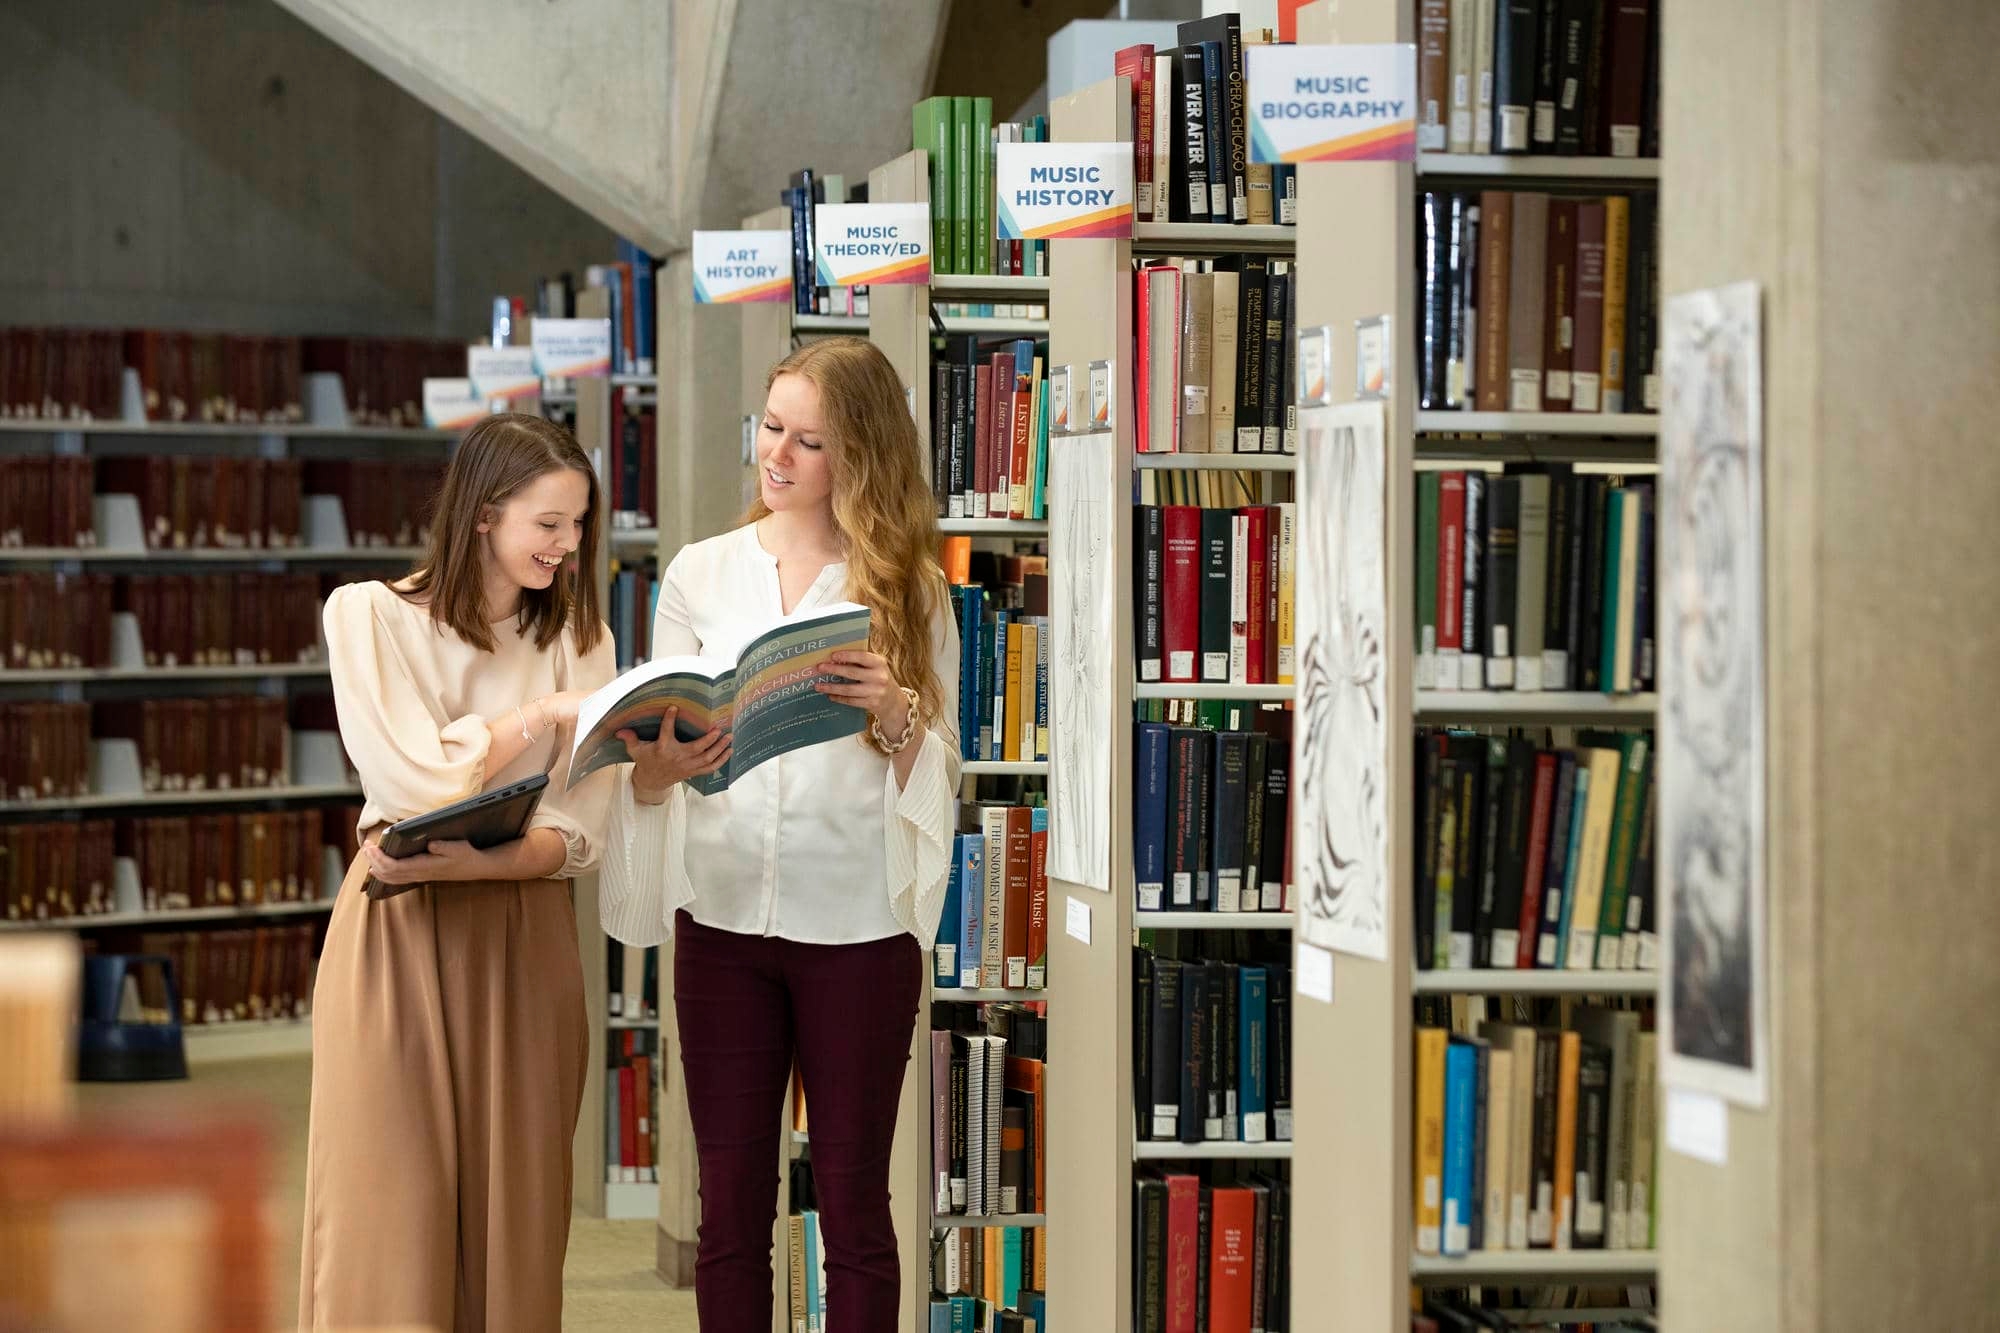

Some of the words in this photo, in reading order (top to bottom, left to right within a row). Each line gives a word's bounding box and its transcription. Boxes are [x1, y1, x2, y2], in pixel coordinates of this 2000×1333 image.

[1141, 79, 1151, 94] JUST
[1229, 71, 1242, 110] OPERA
[1295, 77, 1370, 94] MUSIC
[1141, 95, 1151, 105] ONE
[1141, 105, 1151, 114] OF
[1186, 83, 1204, 118] EVER
[1262, 101, 1405, 119] BIOGRAPHY
[1141, 114, 1151, 127] THE
[1187, 121, 1205, 164] AFTER
[1230, 117, 1244, 171] CHICAGO
[1030, 166, 1100, 183] MUSIC
[1016, 189, 1115, 206] HISTORY
[847, 226, 898, 239] MUSIC
[726, 249, 759, 262] ART
[824, 243, 922, 257] THEORY/ED
[706, 265, 778, 278] HISTORY
[1251, 345, 1260, 363] THE
[1251, 363, 1259, 385] NEW
[1250, 386, 1258, 406] MET
[956, 398, 965, 418] what
[998, 401, 1008, 429] Listen
[1017, 403, 1028, 445] LISTEN
[956, 420, 965, 449] makes
[956, 449, 965, 457] it
[954, 457, 963, 485] great?
[1039, 630, 1048, 669] GUIDELINES
[739, 639, 828, 688] LITERATURE
[1039, 670, 1047, 684] FOR
[737, 675, 845, 722] PERFORMANC
[738, 667, 815, 712] TEACHING
[1039, 685, 1047, 705] STYLE
[991, 824, 1002, 844] THE
[989, 846, 1001, 905] ENJOYMENT
[989, 906, 1000, 919] OF
[1032, 889, 1044, 928] Music
[967, 917, 978, 950] Music
[988, 922, 1000, 954] MUSIC
[953, 1303, 963, 1326] THE
